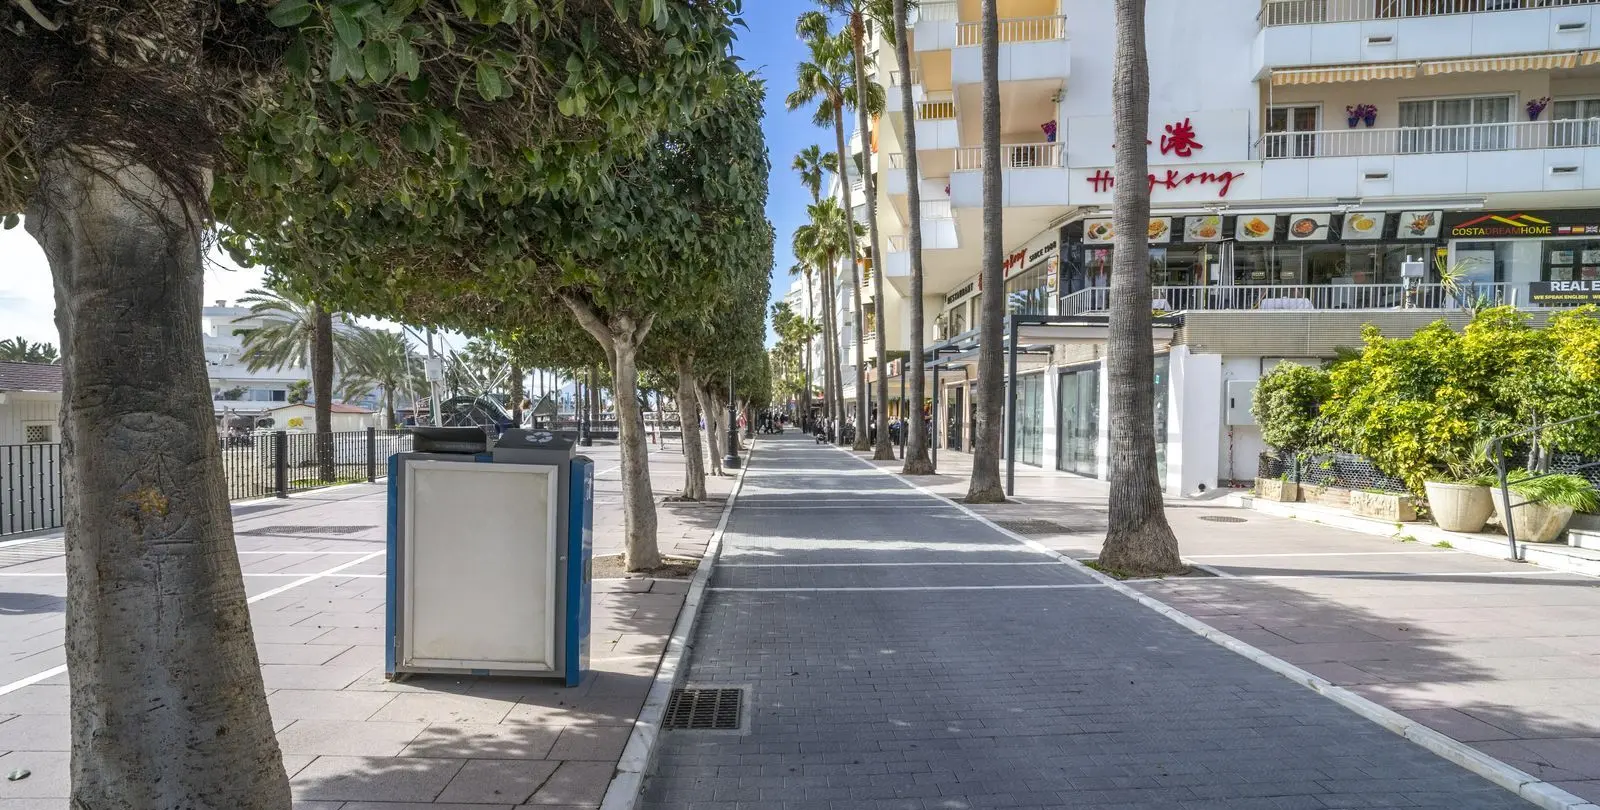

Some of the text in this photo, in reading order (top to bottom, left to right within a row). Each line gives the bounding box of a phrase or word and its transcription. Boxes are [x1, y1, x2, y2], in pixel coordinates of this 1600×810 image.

[1452, 226, 1552, 236] COSTADREAMHOME
[1029, 248, 1044, 262] SINCE
[1551, 281, 1589, 291] REAL
[947, 282, 974, 305] RESTAURANT
